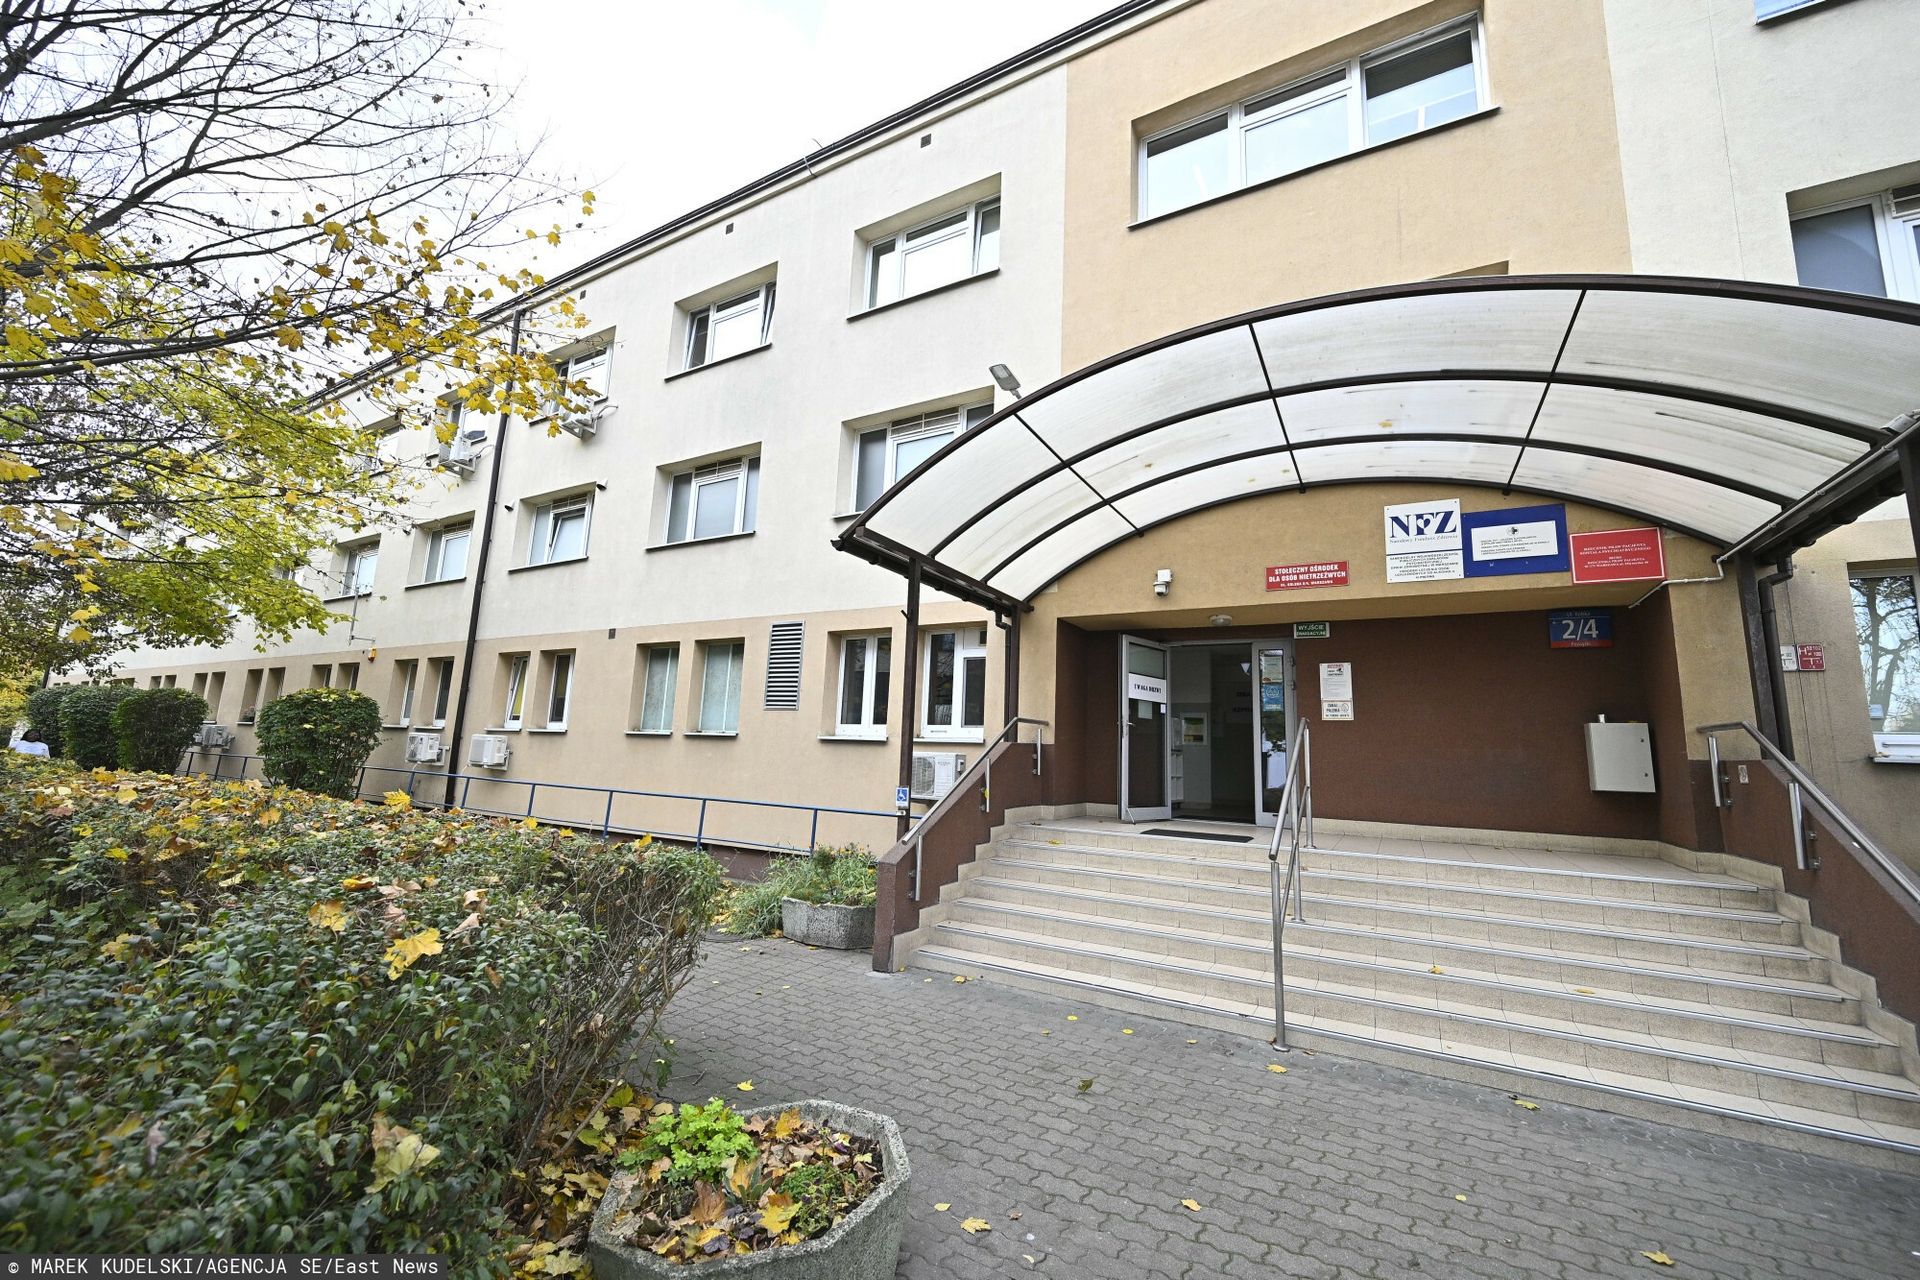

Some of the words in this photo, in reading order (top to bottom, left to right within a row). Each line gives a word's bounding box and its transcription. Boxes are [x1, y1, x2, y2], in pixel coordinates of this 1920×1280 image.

[1389, 510, 1457, 538] NFZ
[1274, 567, 1308, 575] STOŁECZNY
[1310, 564, 1339, 572] OŚRODEK
[1281, 574, 1298, 582] OSÓB
[1299, 571, 1346, 580] NIETRZEŹWYCH
[1562, 619, 1599, 641] 2/4
